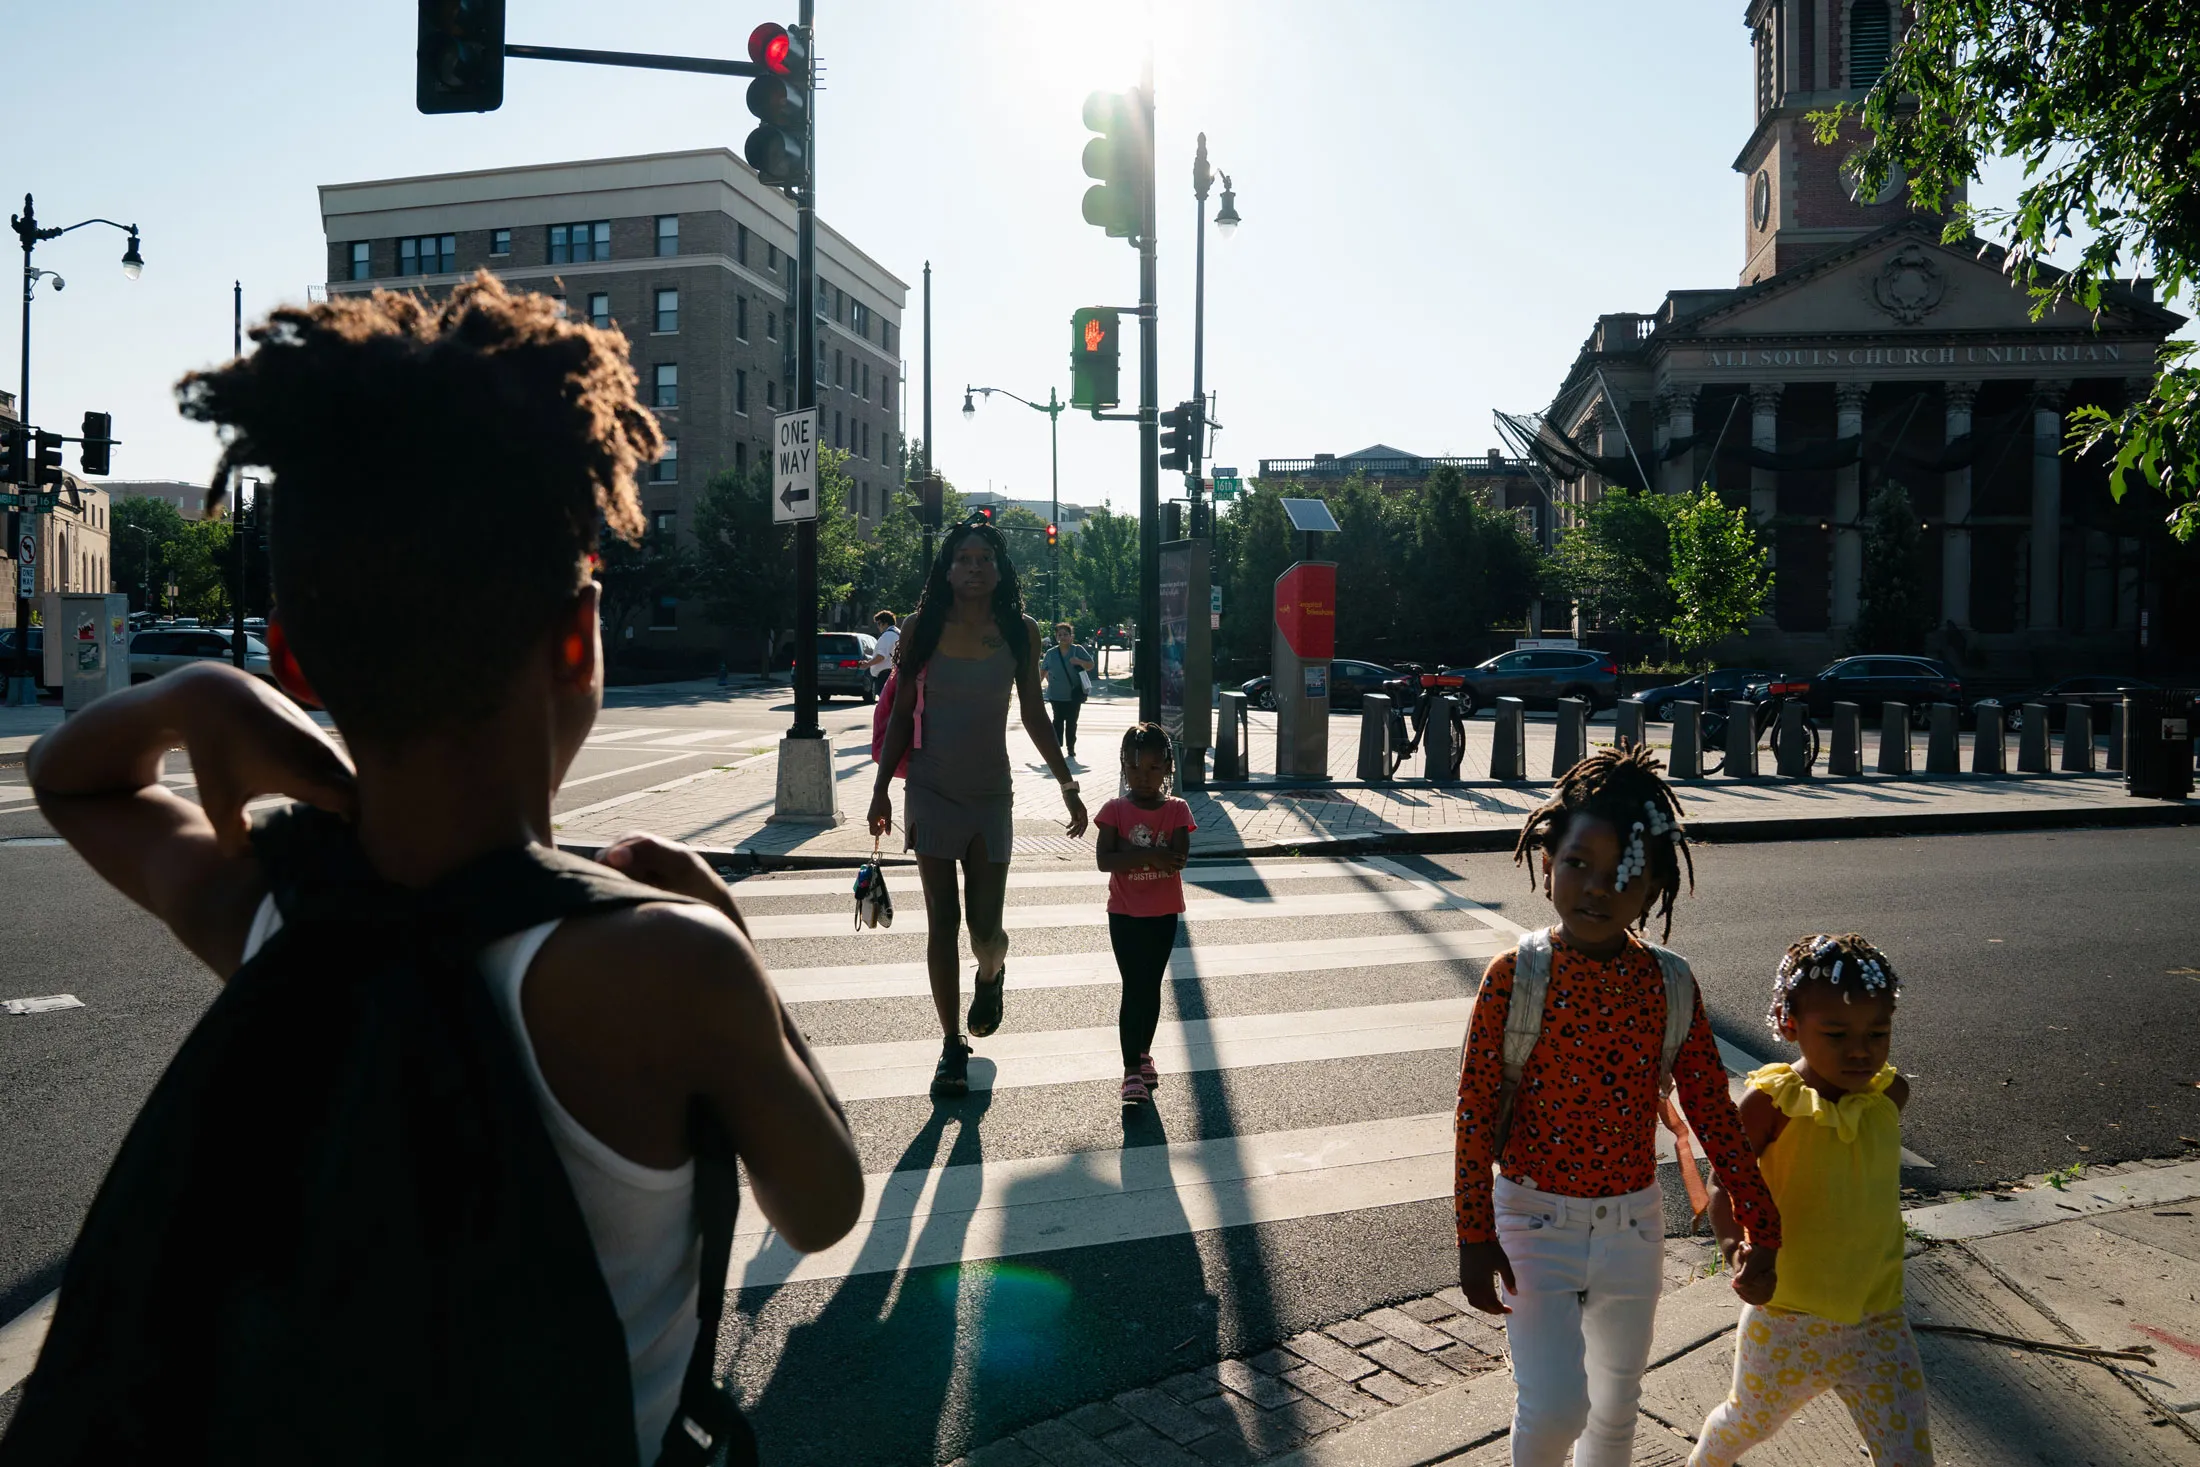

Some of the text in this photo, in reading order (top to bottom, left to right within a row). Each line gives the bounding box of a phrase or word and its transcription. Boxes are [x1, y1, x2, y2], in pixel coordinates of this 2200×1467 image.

[1707, 344, 2120, 367] ALL SOULS CHURCH UNITARIAN
[781, 420, 809, 447] ONE
[780, 448, 811, 475] WAY
[1216, 480, 1233, 491] 16th
[22, 569, 33, 577] ONE
[22, 578, 33, 586] WAY
